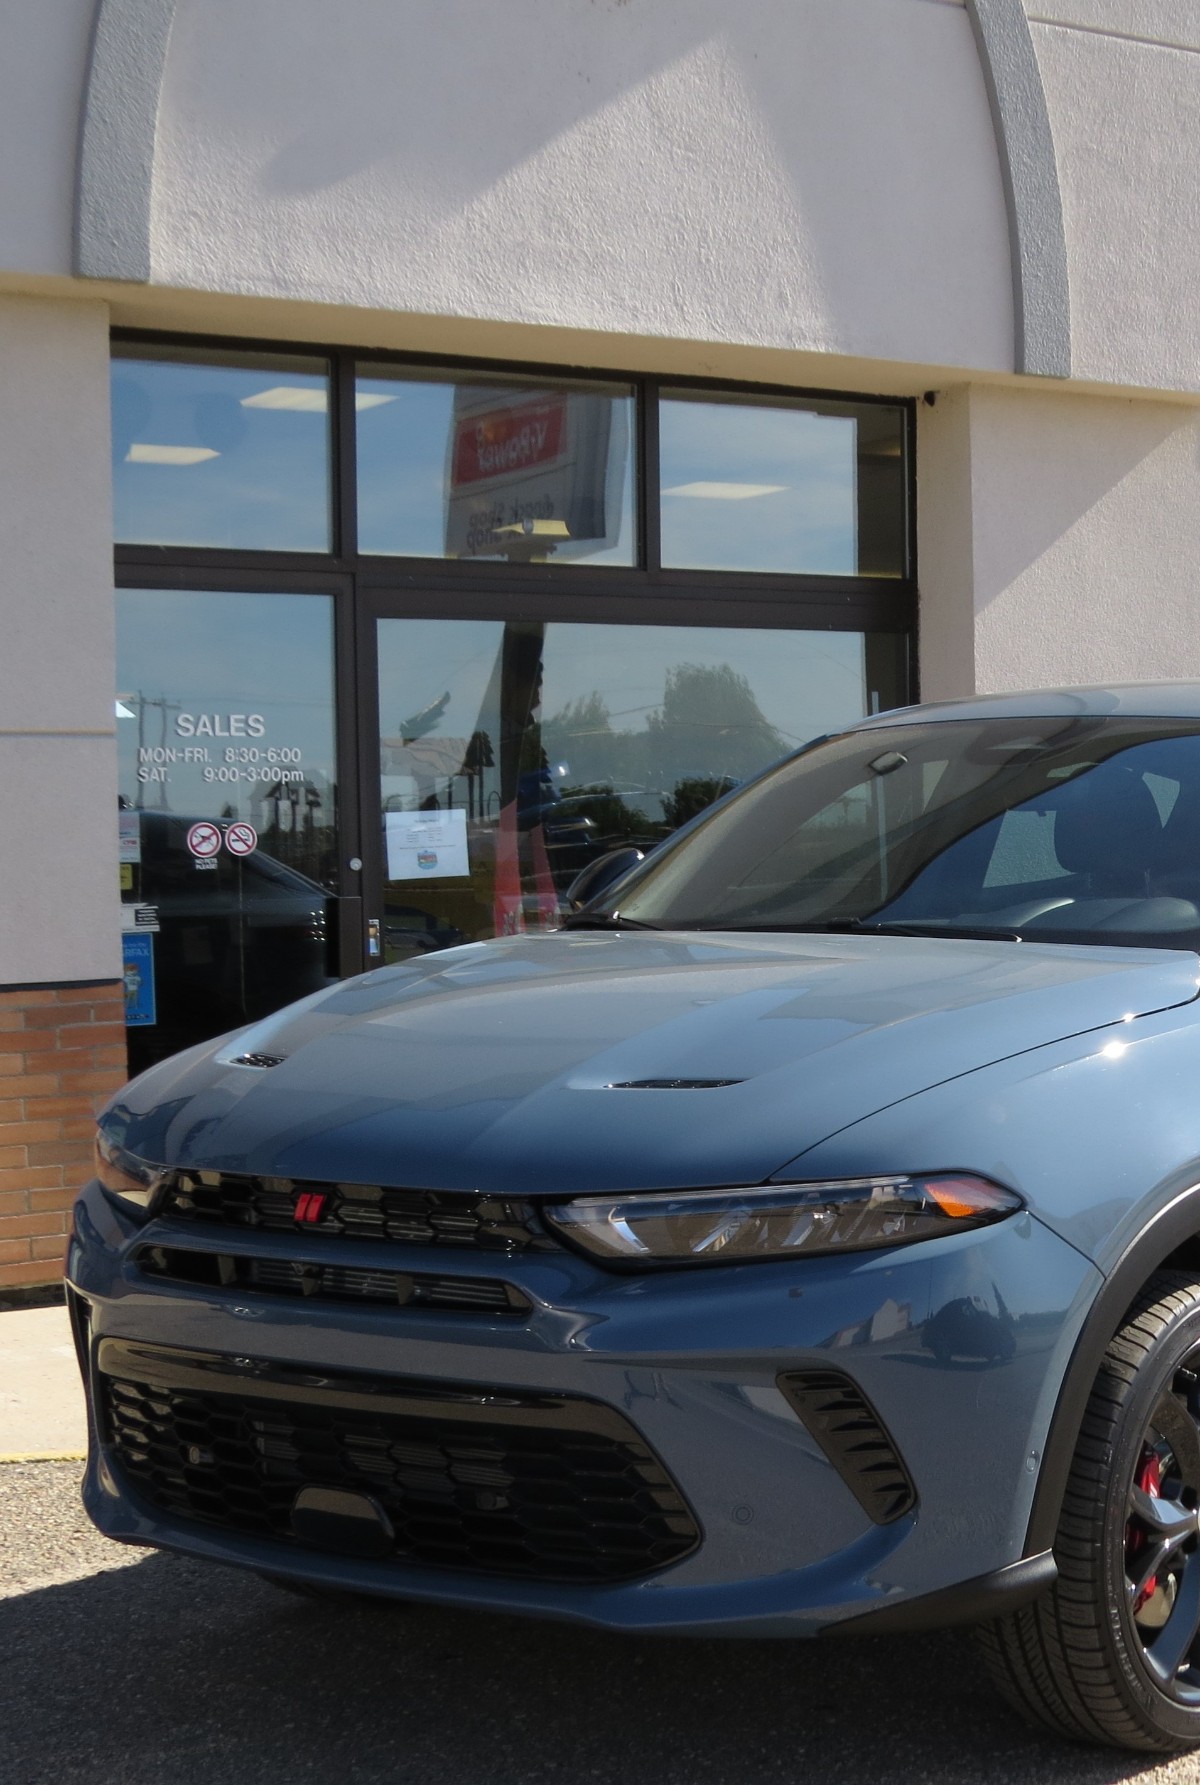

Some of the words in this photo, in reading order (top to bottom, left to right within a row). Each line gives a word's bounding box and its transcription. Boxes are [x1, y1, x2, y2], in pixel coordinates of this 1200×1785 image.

[176, 713, 266, 737] SALES
[139, 748, 212, 763] MON-FRI.
[224, 748, 302, 763] 8:30-6:00
[138, 767, 172, 783] SAT.
[203, 767, 304, 784] 9:00-3:00pm
